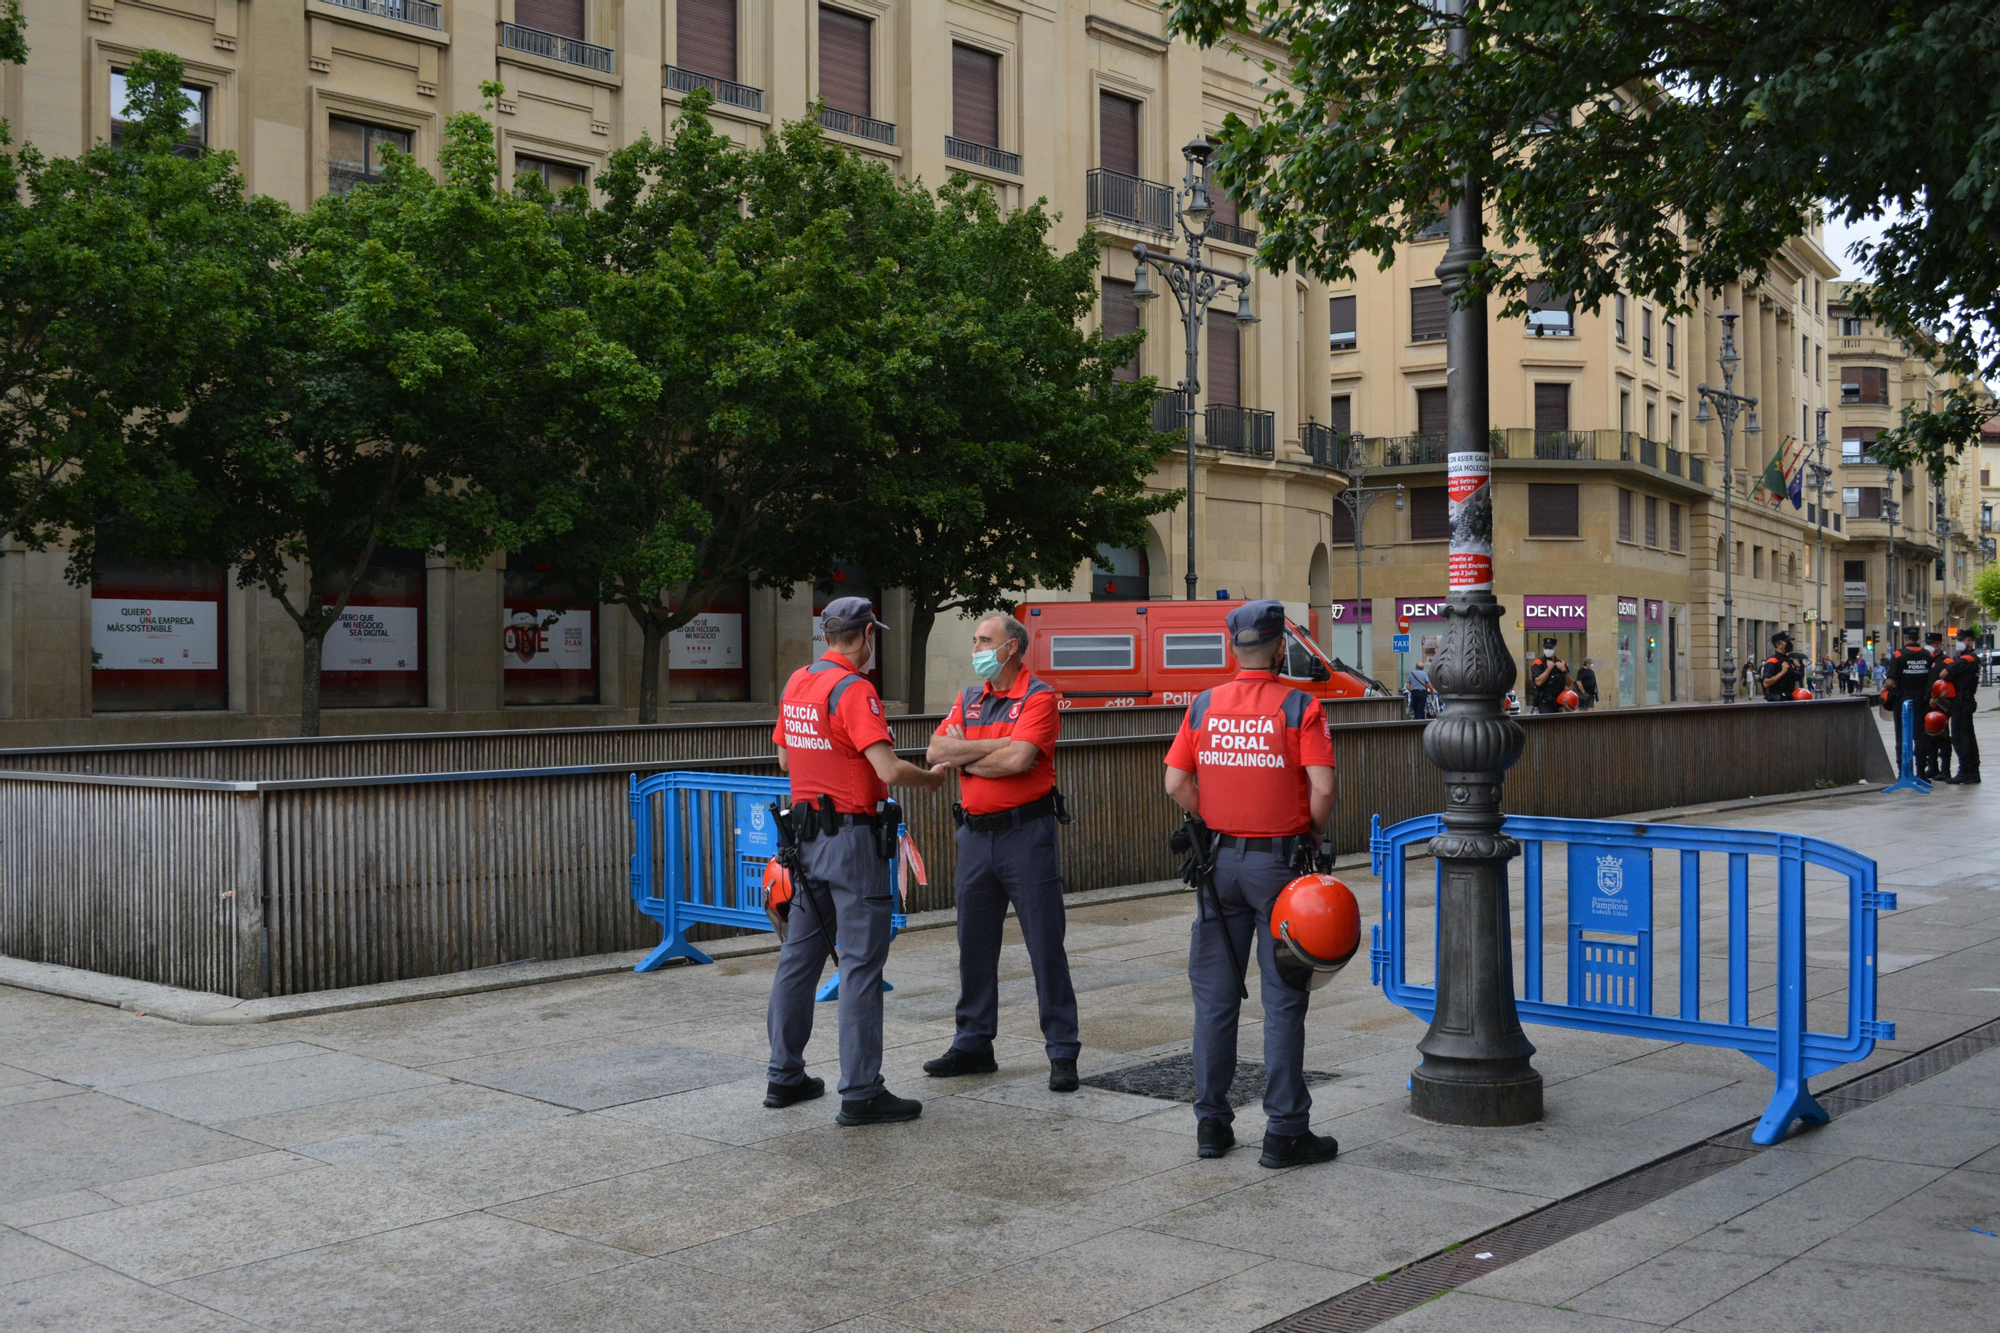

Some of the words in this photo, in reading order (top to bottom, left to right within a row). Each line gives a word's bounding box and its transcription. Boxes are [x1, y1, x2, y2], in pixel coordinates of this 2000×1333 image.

[121, 607, 152, 617] QUIERO
[1526, 605, 1585, 618] DENTIX
[1618, 601, 1637, 616] DENTIX
[139, 616, 157, 624] UNA
[158, 617, 195, 625] EMPRESA
[338, 614, 359, 622] UIERO
[359, 614, 375, 622] QUE
[106, 622, 125, 632] MÁS
[126, 624, 173, 633] SOSTENIBLE
[343, 621, 352, 629] MI
[353, 622, 384, 630] NEGOCIO
[349, 629, 363, 637] SEA
[363, 629, 389, 637] DIGITAL
[693, 632, 717, 640] NEGOCIO
[151, 657, 165, 665] ONE
[1114, 697, 1135, 708] 112
[783, 703, 819, 722] POLICÍA
[785, 718, 818, 735] FORAL
[1207, 715, 1275, 734] POLICÍA
[1211, 734, 1270, 751] FORAL
[1198, 750, 1285, 768] FORUZAINGOA
[1592, 901, 1628, 911] Pamplona
